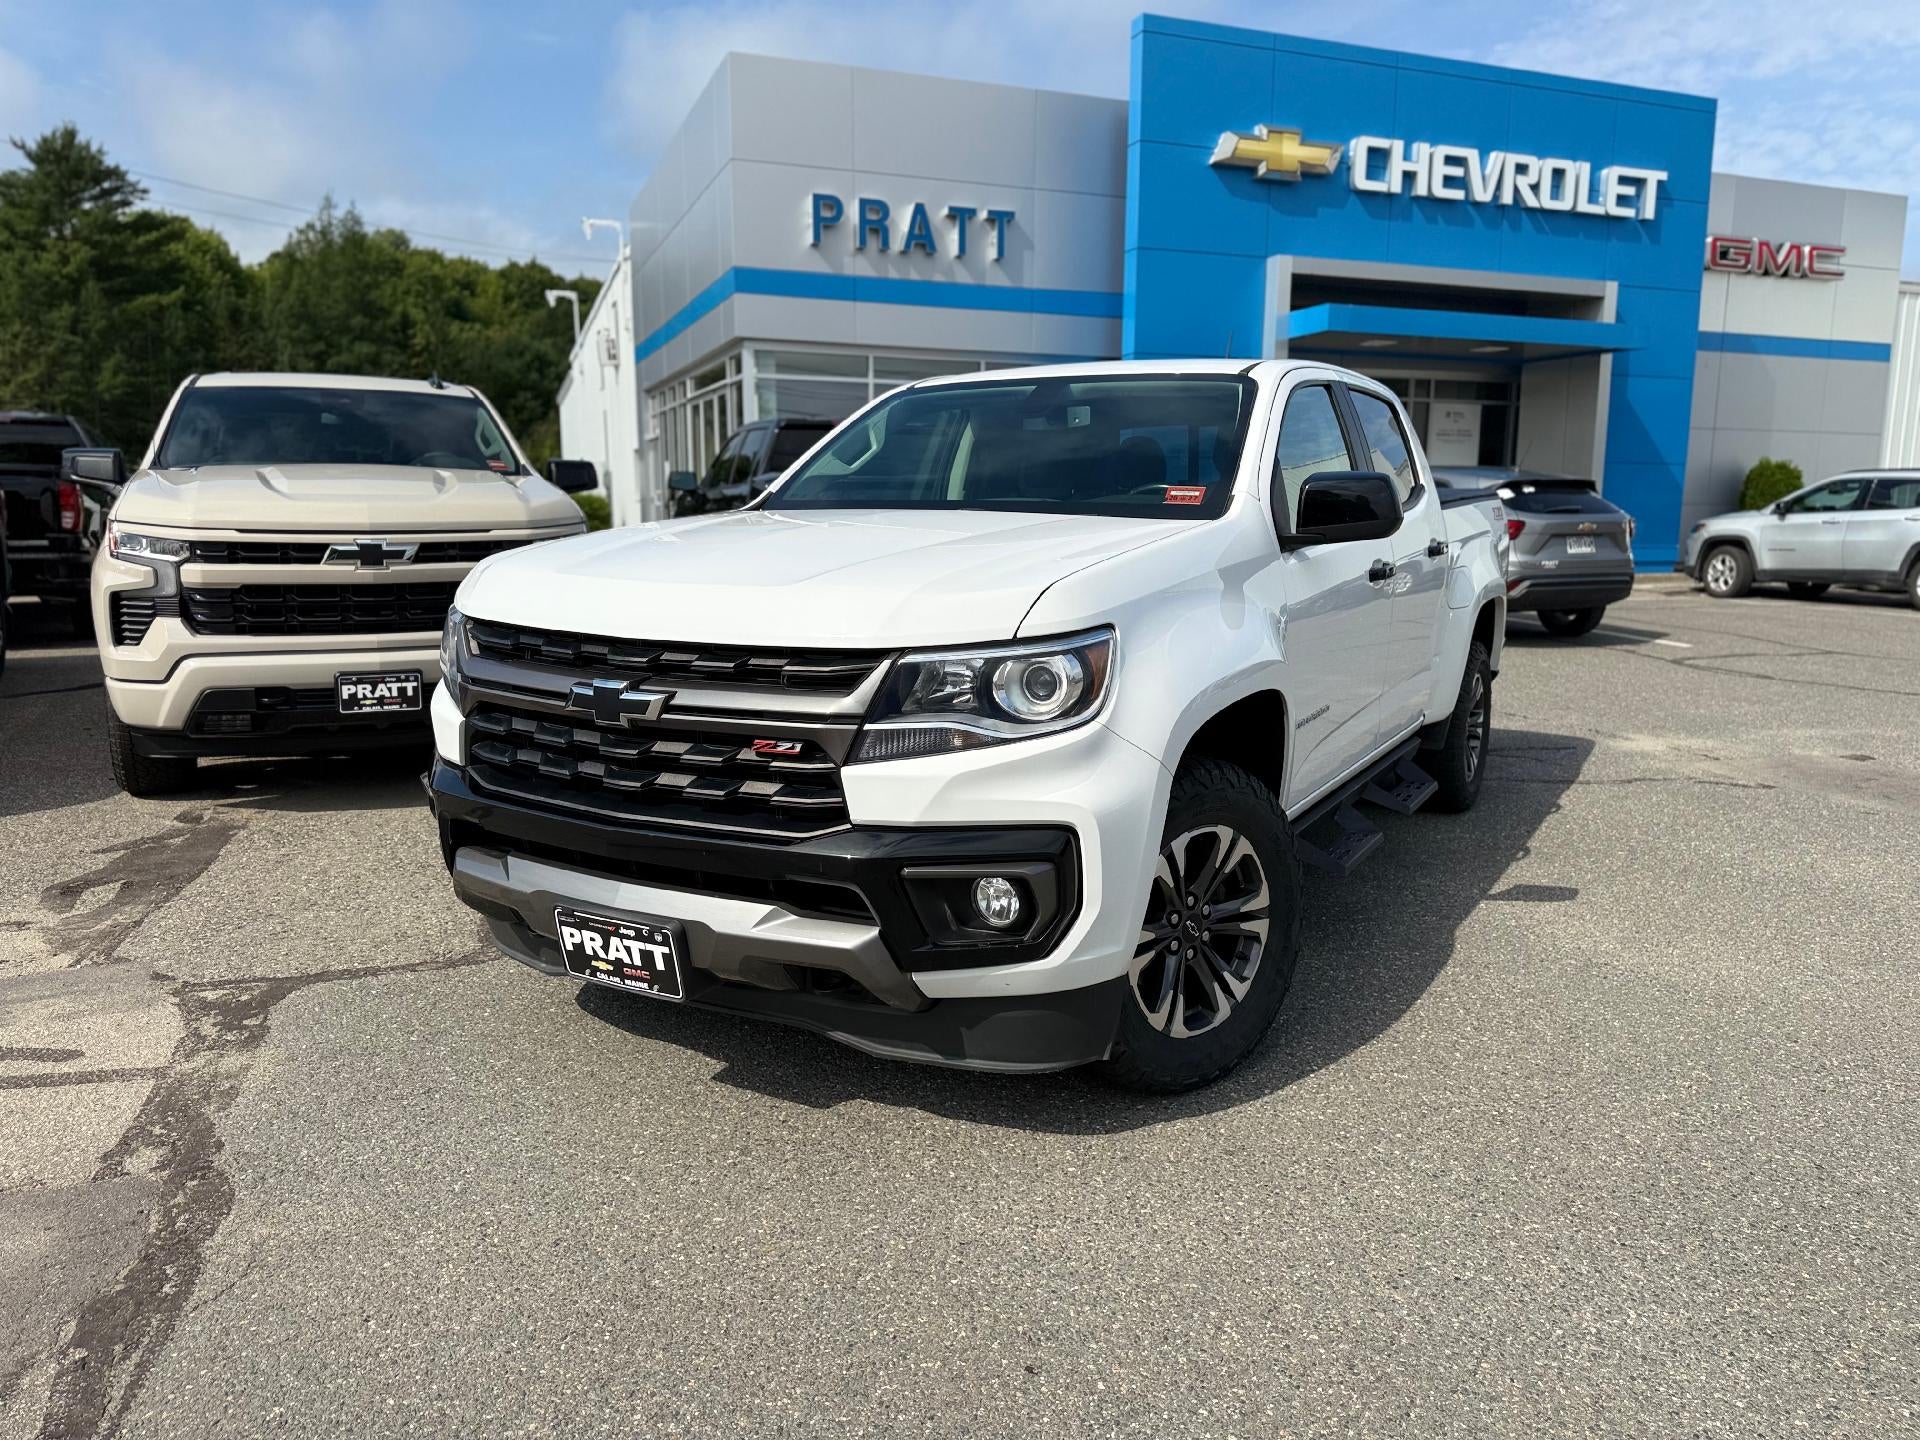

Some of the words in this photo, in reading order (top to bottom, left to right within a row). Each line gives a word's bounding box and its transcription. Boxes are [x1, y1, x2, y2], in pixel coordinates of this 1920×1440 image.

[1350, 135, 1668, 220] CHEVROLET
[810, 193, 1015, 260] PRATT
[1705, 236, 1847, 280] GMC
[341, 682, 418, 699] PRATT
[752, 739, 803, 754] Z71
[618, 926, 636, 937] Jeep
[560, 925, 671, 971] PRATT
[623, 967, 651, 980] GMC
